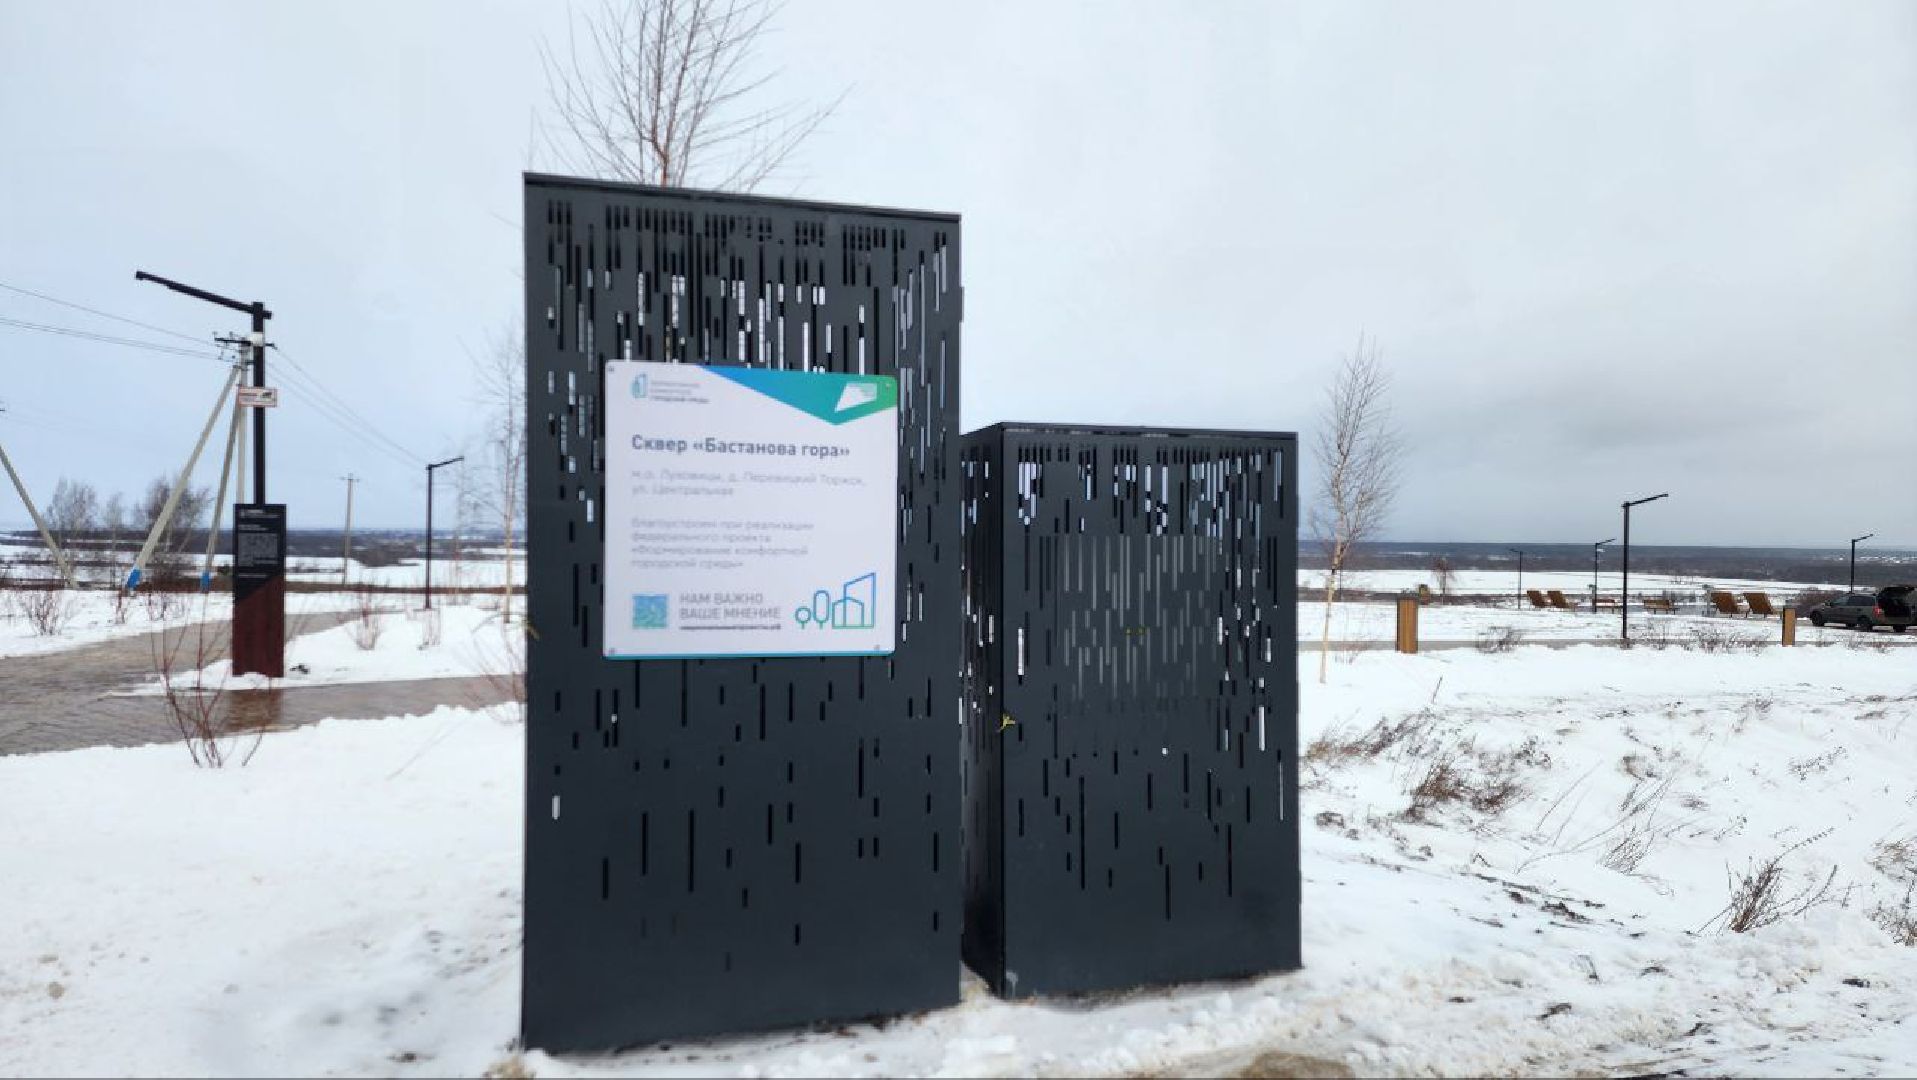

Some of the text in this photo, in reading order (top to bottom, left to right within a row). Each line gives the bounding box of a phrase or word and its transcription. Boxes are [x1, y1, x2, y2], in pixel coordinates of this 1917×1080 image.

[631, 434, 850, 460] Сквер «Бастанова гора»
